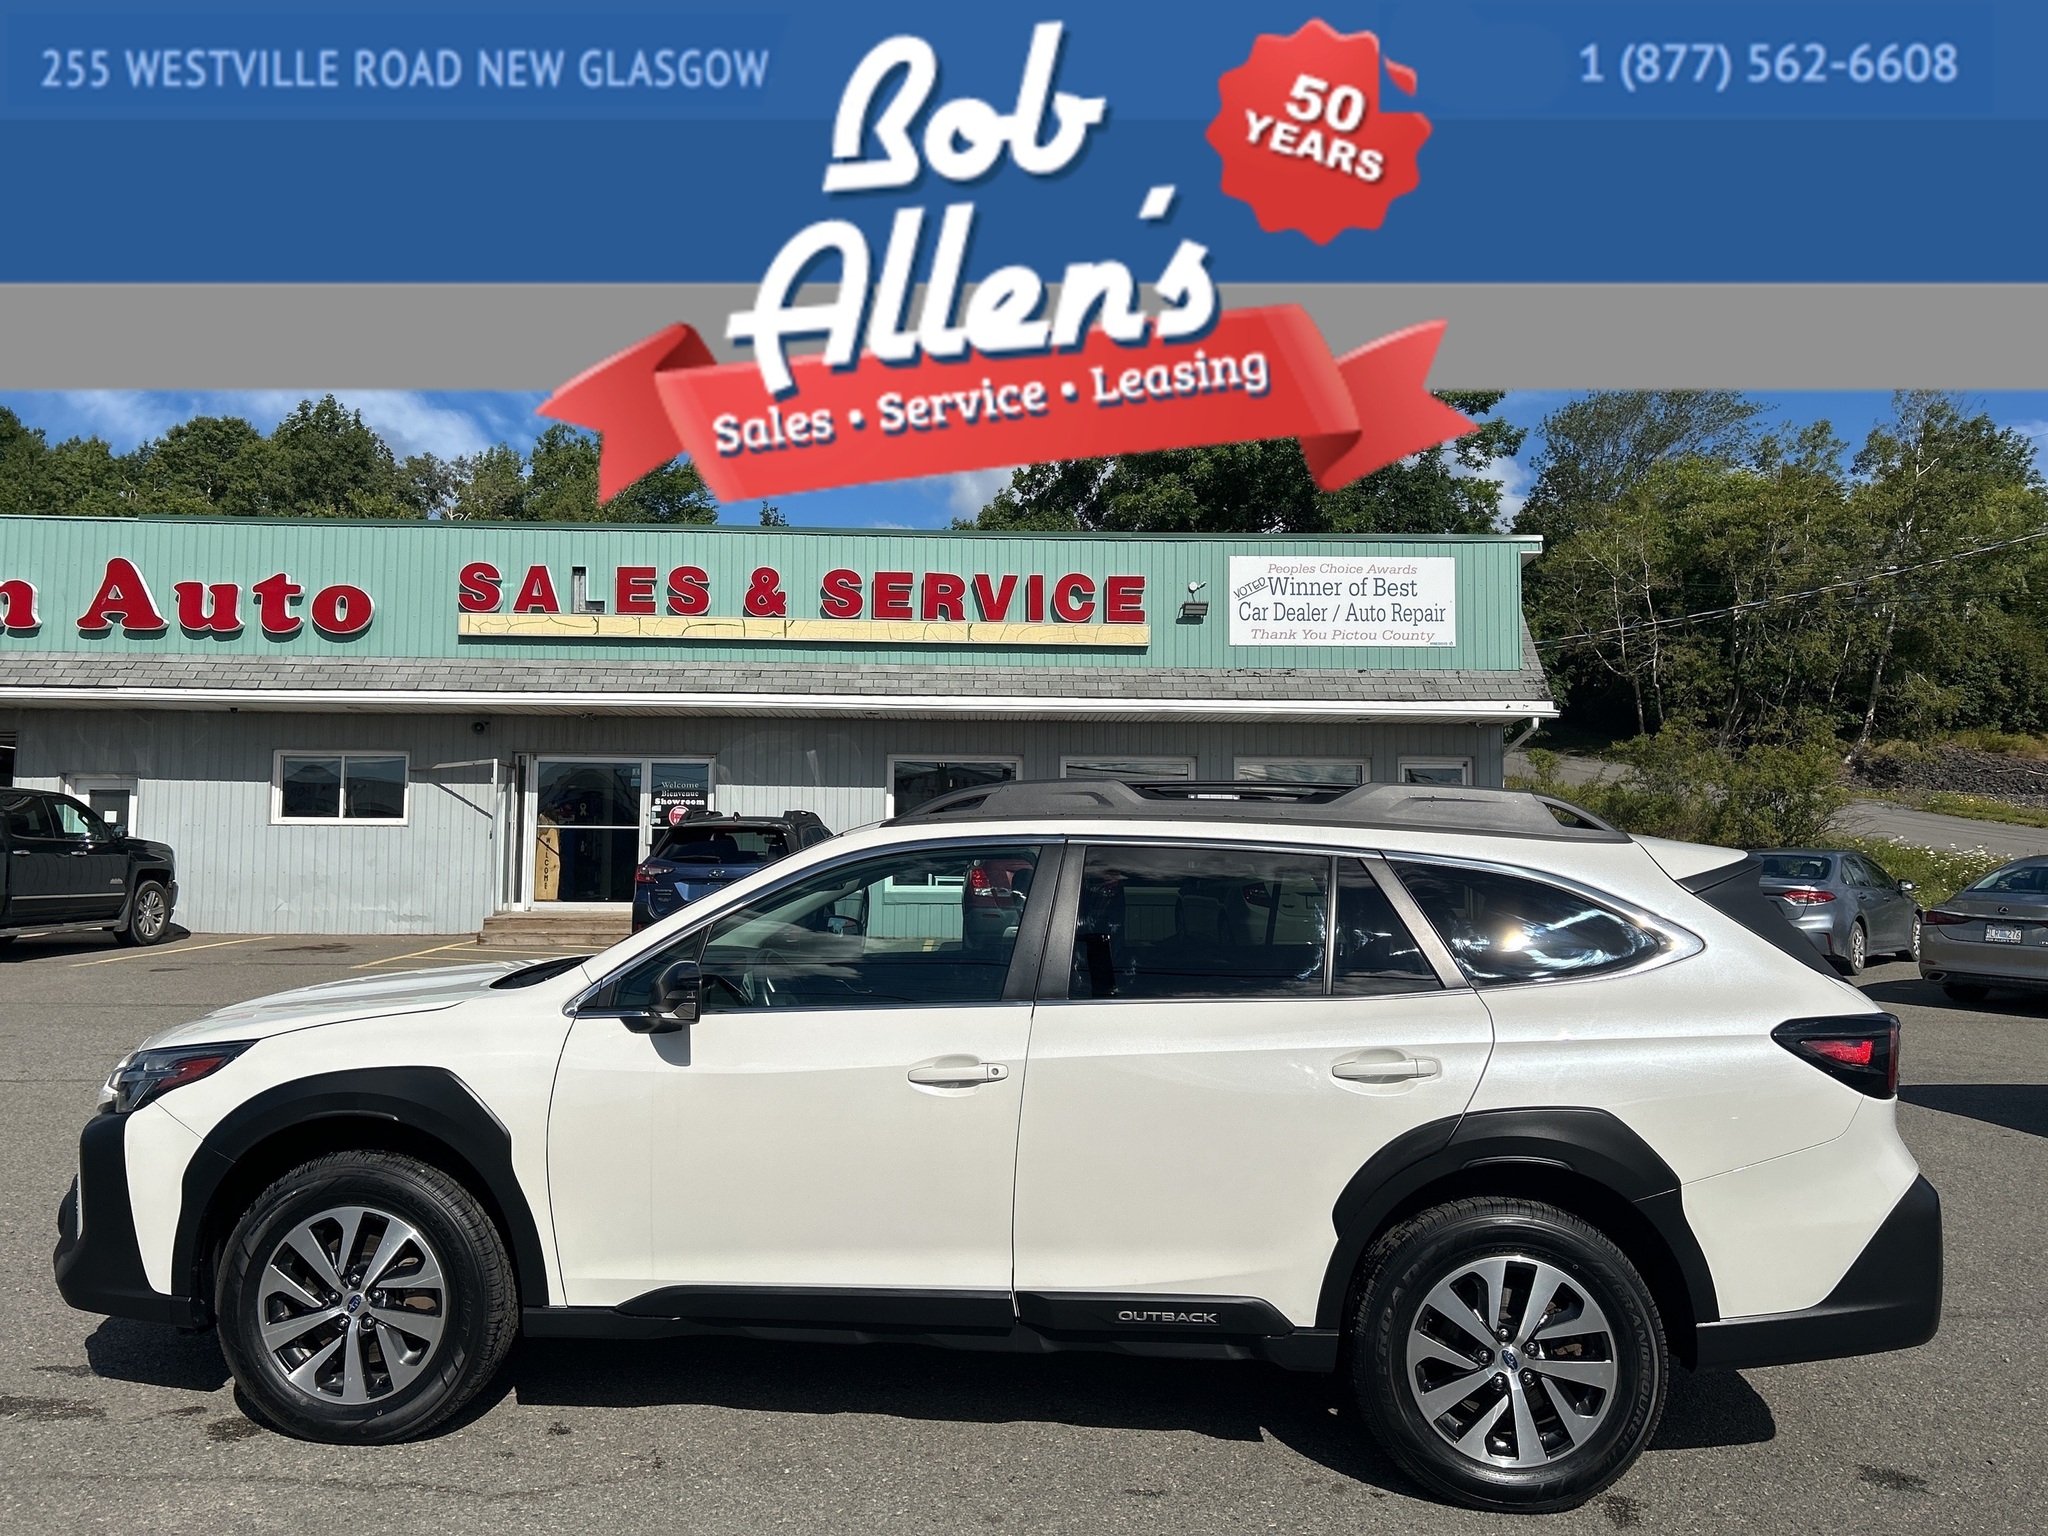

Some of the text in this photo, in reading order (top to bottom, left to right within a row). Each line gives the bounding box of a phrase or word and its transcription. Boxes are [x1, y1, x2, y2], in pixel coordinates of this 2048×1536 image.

[1267, 563, 1418, 575] Peoples Choice Awards
[76, 557, 376, 637] Auto
[458, 562, 1146, 624] SALES & SERVICE
[1233, 577, 1268, 598] VOTED
[1268, 577, 1418, 597] Winner of Best
[1238, 601, 1446, 626] Car Dealer / Auto Repair
[1250, 628, 1435, 642] Thank You Pictou County
[654, 797, 705, 805] Showroom
[1118, 1310, 1217, 1323] OUTBACK
